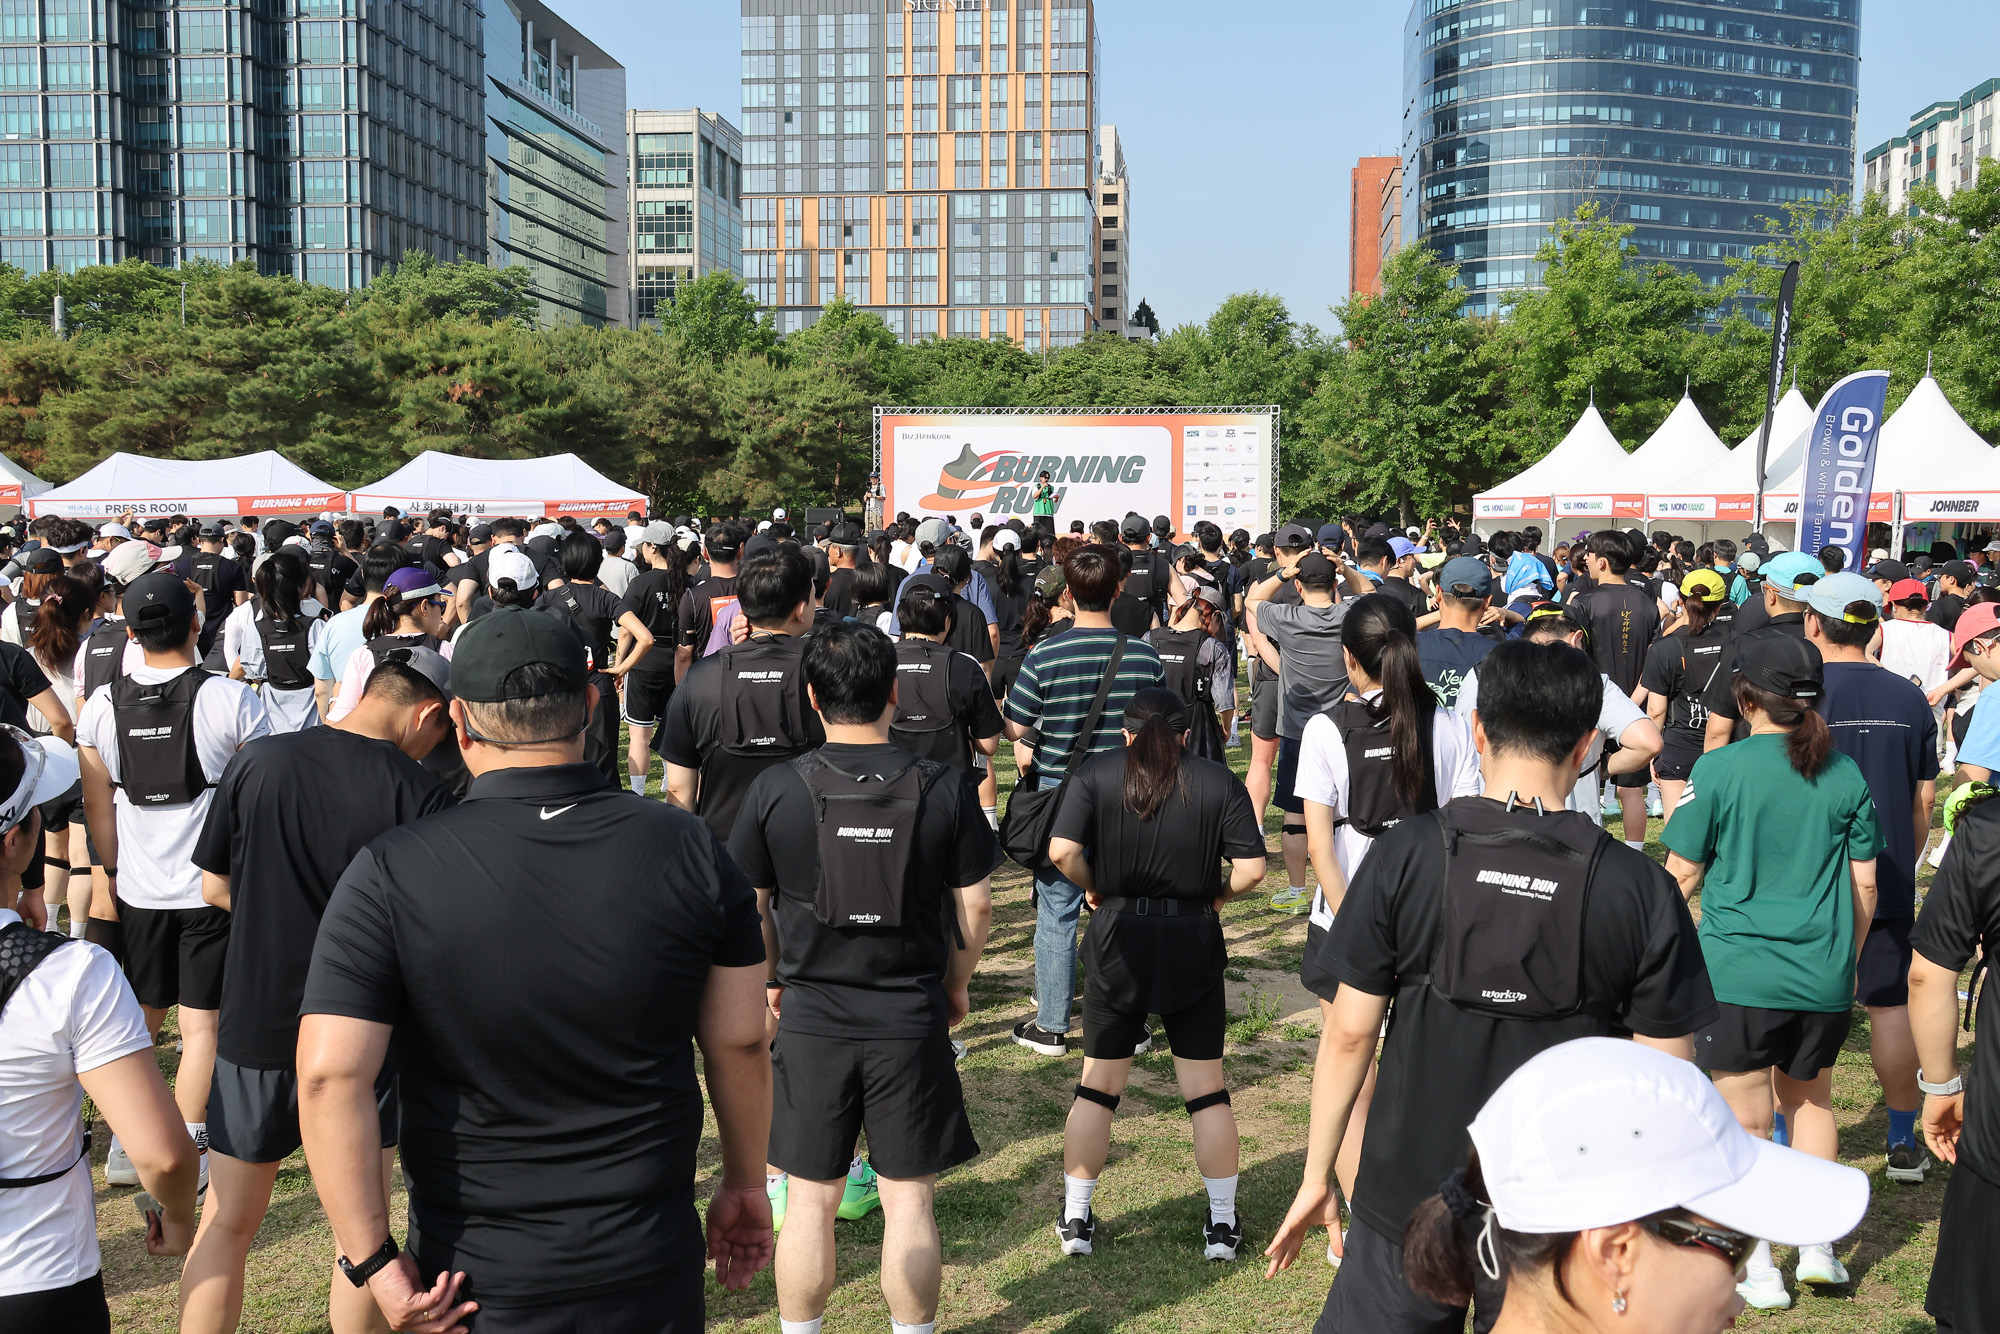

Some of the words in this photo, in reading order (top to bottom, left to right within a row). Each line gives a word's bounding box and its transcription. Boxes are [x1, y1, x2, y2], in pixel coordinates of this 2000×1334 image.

[1821, 414, 1836, 455] Brown
[1820, 458, 1831, 468] &
[990, 455, 1147, 484] BURNING
[1816, 471, 1829, 507] white
[105, 503, 147, 514] PRESS
[150, 502, 188, 513] ROOM
[251, 498, 303, 508] BURNING
[304, 497, 330, 506] RUN
[557, 502, 606, 511] BURNING
[607, 502, 631, 511] RUN
[1929, 500, 1980, 512] JOHNBER
[738, 671, 768, 679] BURNING
[768, 671, 784, 679] RUN
[128, 728, 157, 736] BURNING
[157, 726, 172, 735] RUN
[1364, 746, 1395, 758] BURNIN
[837, 827, 875, 837] BURNING
[875, 828, 894, 838] RUN
[1476, 870, 1531, 889] BURNING
[1530, 878, 1558, 894] RUN
[1501, 887, 1516, 895] Casual
[1517, 889, 1535, 898] Running
[1535, 892, 1552, 901] Festival
